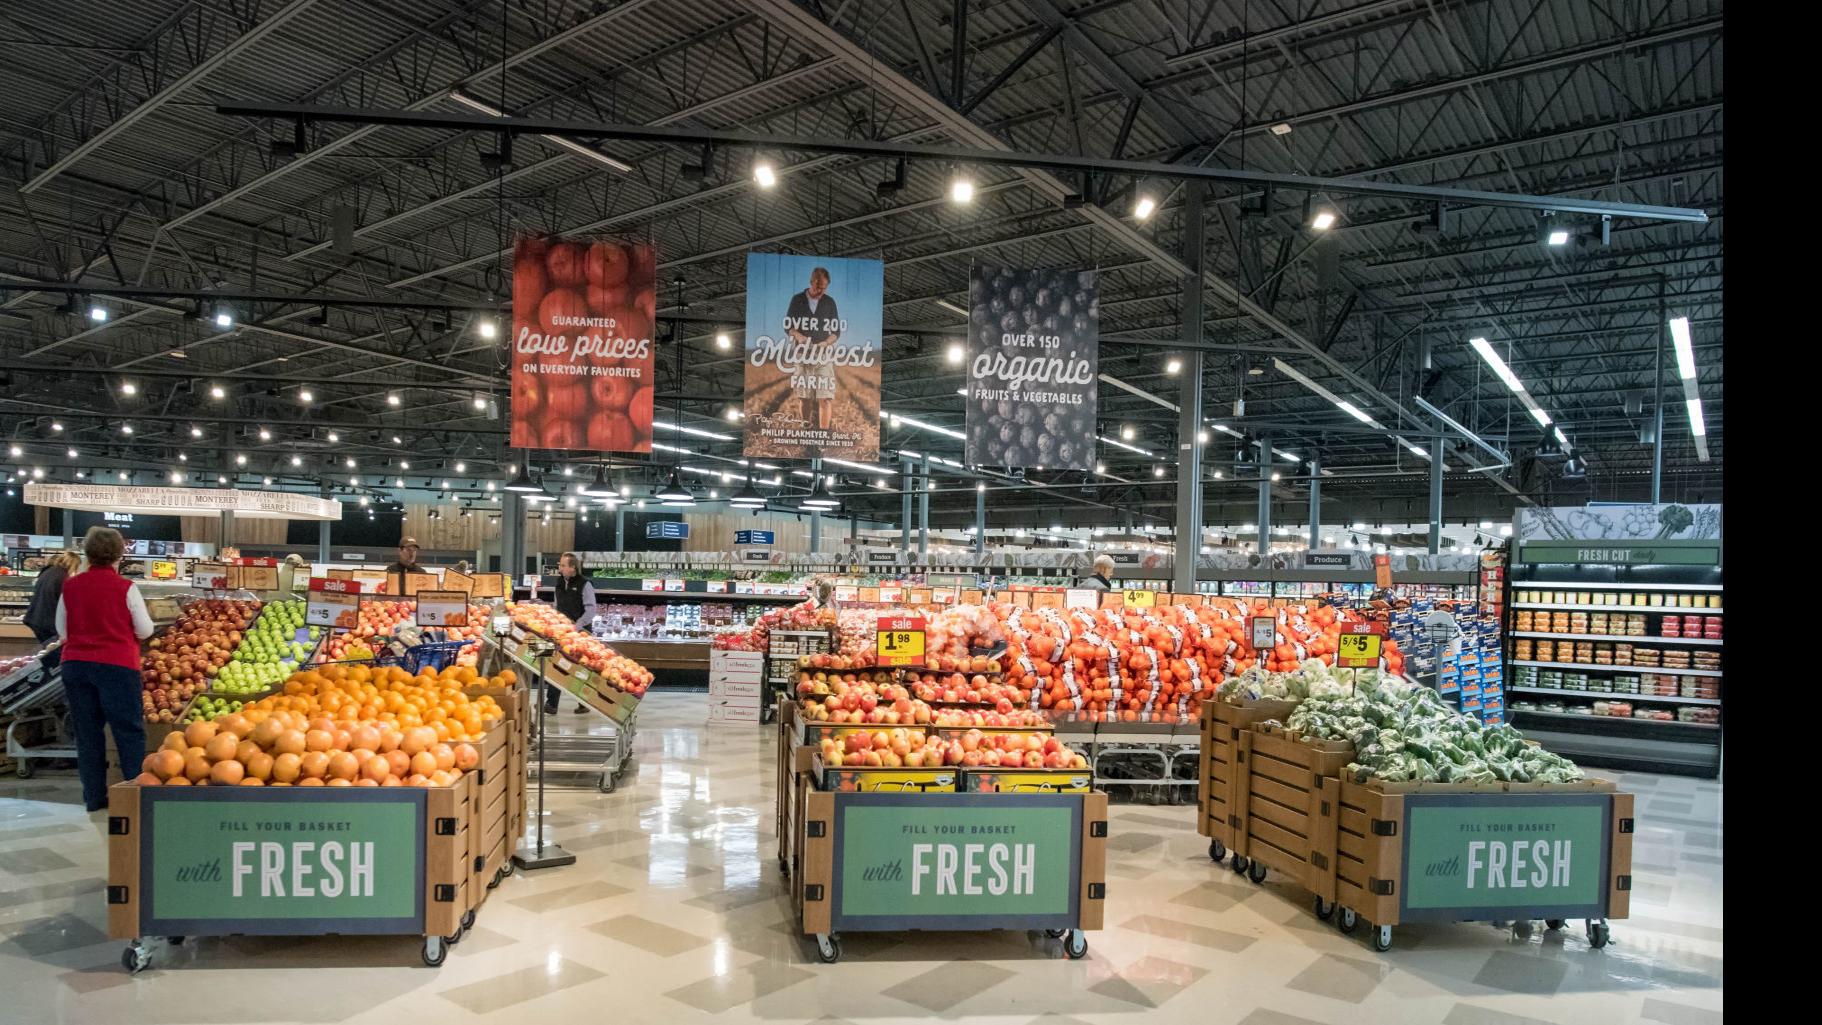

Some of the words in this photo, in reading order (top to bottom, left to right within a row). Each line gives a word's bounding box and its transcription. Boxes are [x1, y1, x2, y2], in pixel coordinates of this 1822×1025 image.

[551, 315, 616, 328] GUARANTEED
[782, 316, 819, 331] OVER
[823, 318, 848, 332] 200
[516, 326, 568, 355] low
[570, 330, 650, 362] prices
[1002, 333, 1035, 347] OVER
[1039, 335, 1060, 348] 150
[750, 335, 875, 374] Midwest
[523, 363, 537, 373] ON
[540, 363, 588, 376] EVERYDAY
[591, 366, 641, 378] FAVORITES
[972, 350, 1093, 390] organic
[790, 374, 836, 390] FARMS
[975, 389, 1009, 401] FRUITS
[1012, 391, 1020, 401] &
[1023, 391, 1082, 404] VEGETABLES
[761, 428, 785, 437] PHILIP
[71, 492, 114, 500] MONTEREY
[195, 495, 239, 504] MONTEREY
[104, 511, 133, 522] Meat
[1578, 549, 1609, 561] FRESH
[1612, 549, 1631, 561] CUT
[324, 580, 346, 591] sale
[892, 618, 912, 629] sale
[1353, 622, 1371, 633] sale
[220, 822, 248, 831] FILL
[256, 822, 292, 831] YOUR
[299, 821, 352, 831] BASKET
[902, 825, 927, 834] FILL
[934, 825, 965, 834] YOUR
[971, 825, 1016, 834] BASKET
[1460, 824, 1481, 832] FILL
[1487, 824, 1513, 832] YOUR
[1517, 823, 1556, 832] BASKET
[175, 858, 223, 882] with
[232, 841, 374, 897] FRESH
[862, 858, 904, 882] with
[911, 843, 1035, 895] FRESH
[1425, 856, 1460, 877] with
[1466, 840, 1572, 889] FRESH
